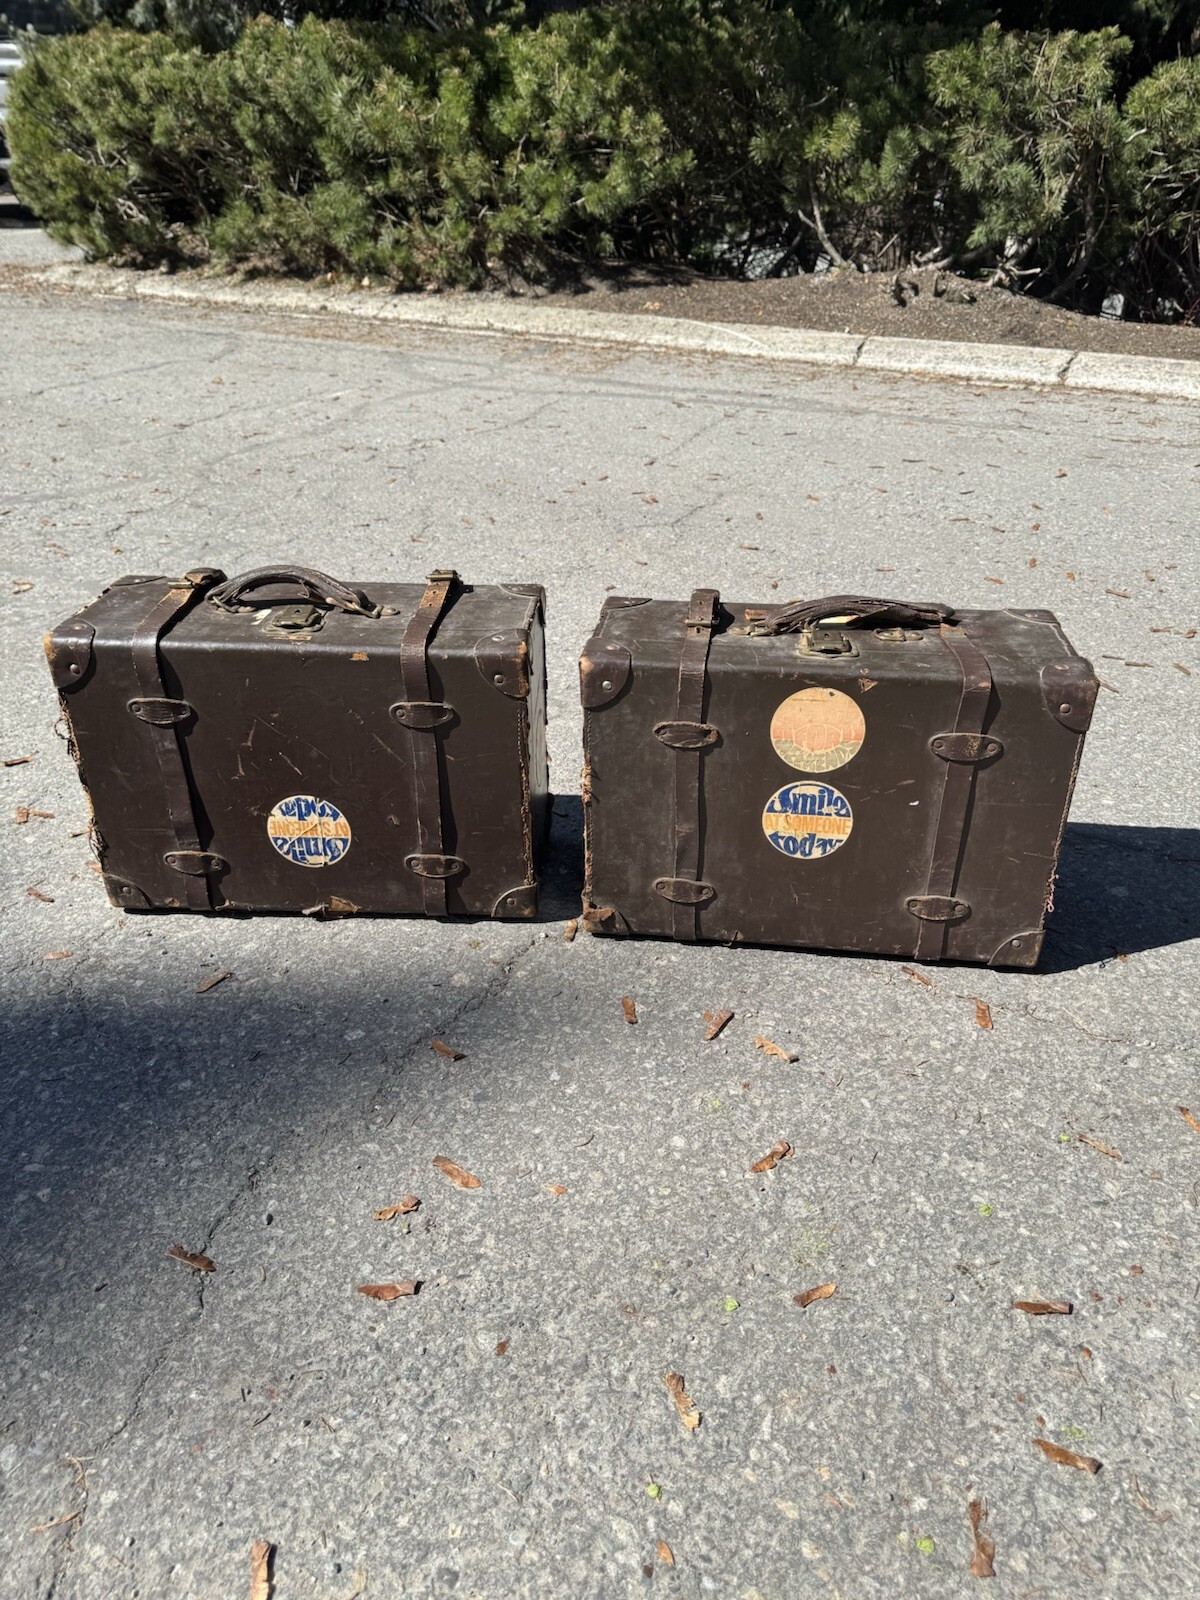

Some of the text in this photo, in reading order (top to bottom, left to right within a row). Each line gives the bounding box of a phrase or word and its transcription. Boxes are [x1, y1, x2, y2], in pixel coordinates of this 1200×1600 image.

[766, 784, 851, 817] Smile
[269, 820, 350, 837] AT SMEONE
[764, 813, 851, 835] AT SOMEONE
[271, 836, 349, 863] Smile
